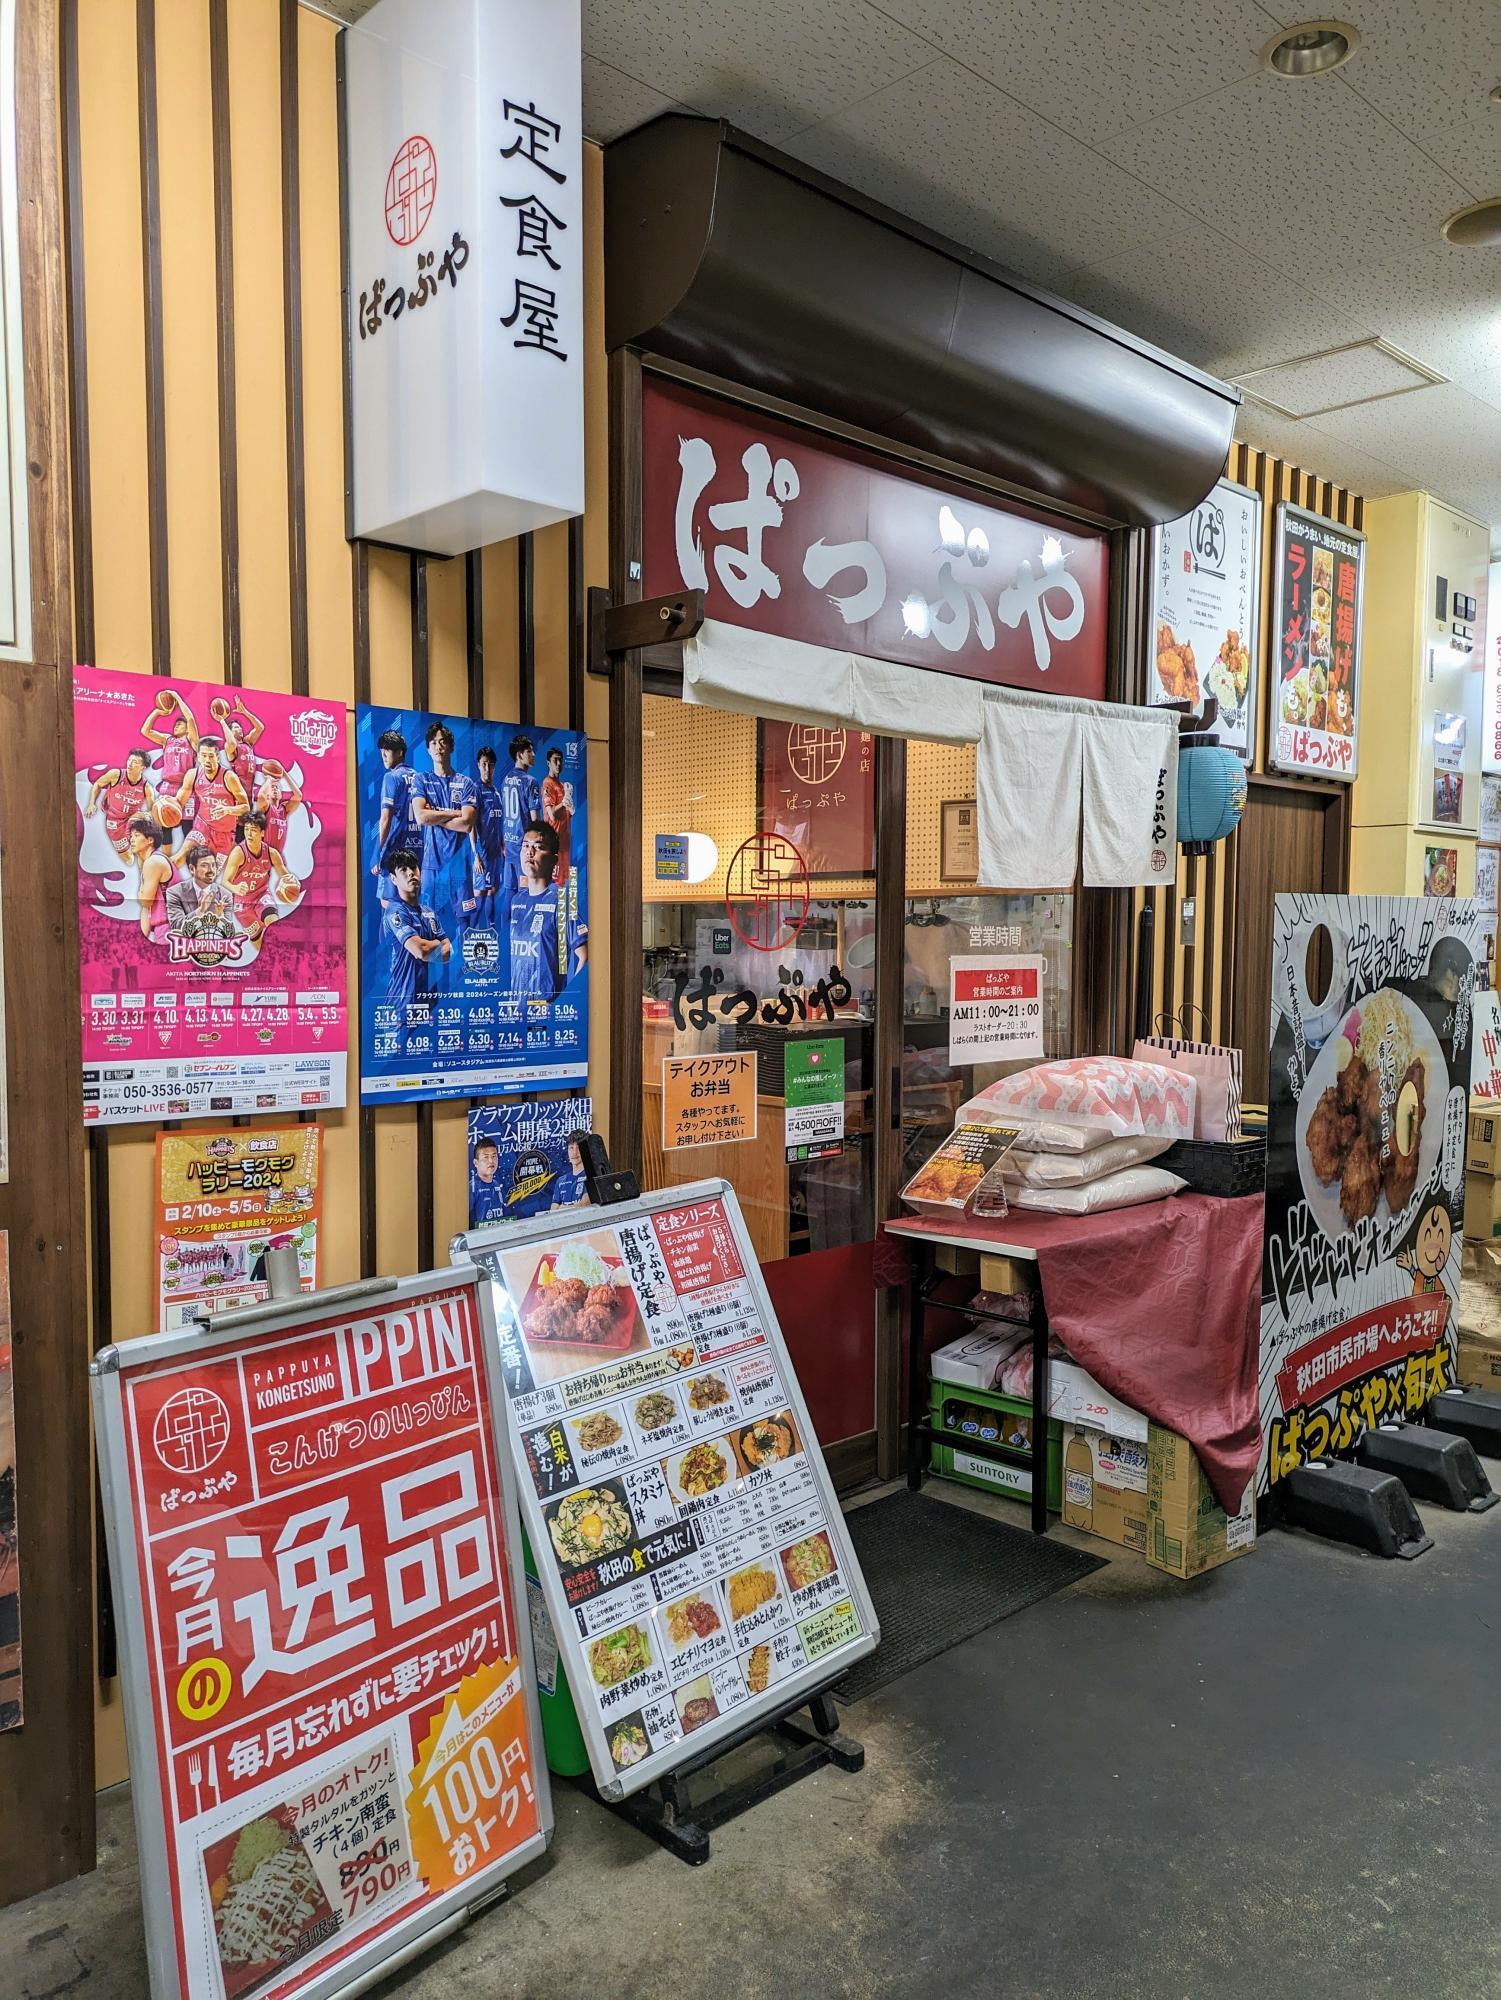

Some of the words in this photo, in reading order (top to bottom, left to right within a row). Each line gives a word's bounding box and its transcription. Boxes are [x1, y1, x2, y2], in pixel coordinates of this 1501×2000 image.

[499, 99, 568, 362] 定食屋
[714, 934, 729, 942] Uber
[969, 926, 1022, 947] 営業時間
[168, 932, 248, 960] HAPPINETS
[514, 940, 540, 957] TDK
[416, 991, 464, 999] ブラウブリッツ秋田
[972, 985, 1023, 998] 営業時間のご案内
[121, 1010, 144, 1025] 3.31
[153, 1010, 177, 1024] 4.10
[185, 1008, 206, 1022] 4.13
[211, 1008, 233, 1022] 4.14
[241, 1008, 262, 1021] 4.27
[267, 1008, 288, 1021] 4.28
[298, 1007, 313, 1020] 5.4
[322, 1006, 337, 1020] 5.5
[374, 1010, 398, 1022] 3.16
[406, 1009, 430, 1021] 3.20
[438, 1008, 461, 1019] 3.30
[469, 1007, 491, 1018] 4.03
[498, 1006, 519, 1017] 4.14
[527, 1005, 547, 1016] 4.28
[555, 1004, 574, 1015] 5.06
[91, 1011, 116, 1026] 3.30
[374, 1038, 398, 1050] 5.26
[406, 1037, 430, 1048] 6.08
[438, 1035, 461, 1047] 6.23
[469, 1034, 490, 1045] 6.30
[498, 1033, 519, 1044] 7.14
[527, 1031, 547, 1042] 8.11
[555, 1030, 574, 1041] 8.25
[669, 1057, 750, 1079] テイクアウト
[123, 1082, 213, 1098] 050-3536-0577
[690, 1078, 730, 1098] お弁当
[468, 1097, 593, 1127] ブラウブリッツ秋田
[681, 1105, 740, 1119] 各種やってます。
[675, 1116, 746, 1132] スタッフへお気軽に
[249, 1139, 278, 1151] 飲食店
[676, 1129, 745, 1146] お申し付け下さい！
[188, 1155, 295, 1179] ハッピーモグモグ
[202, 1172, 281, 1194] ラリー2024
[656, 1203, 720, 1232] 定食シリーズ
[619, 1228, 661, 1319] 唐揚げ定食
[1295, 1309, 1439, 1396] 秋田市民市場へようこそ!!
[253, 1355, 332, 1385] PAPPUYA
[256, 1371, 336, 1410] KONGETSUNO
[513, 1389, 556, 1412] 唐揚げ3個
[641, 1424, 685, 1445] ネギ塩焼肉定食
[580, 1445, 629, 1468] 秘伝の焼肉定食
[748, 1468, 773, 1487] カツ丼
[630, 1480, 665, 1507] スタミナ
[678, 1494, 720, 1517] 回鍋肉定食
[226, 1449, 493, 1697] 逸品
[796, 1600, 822, 1617] らーめん
[733, 1603, 783, 1638] 手仕込みとんかつ
[167, 1546, 232, 1721] 今月の
[737, 1635, 751, 1648] 定食
[670, 1635, 727, 1671] エビチリマヨ定食
[775, 1648, 791, 1663] 餃子
[600, 1669, 664, 1710] 肉野菜炒め定食
[433, 1678, 516, 1765] 今月はこのメニューが
[648, 1709, 676, 1736] 油そば
[423, 1736, 526, 1845] 100円
[287, 1772, 397, 1848] 特製タルタルをガツンと
[312, 1793, 391, 1853] チキン南蛮
[343, 1860, 411, 1918] 790円
[280, 1909, 345, 1963] 今月限定
